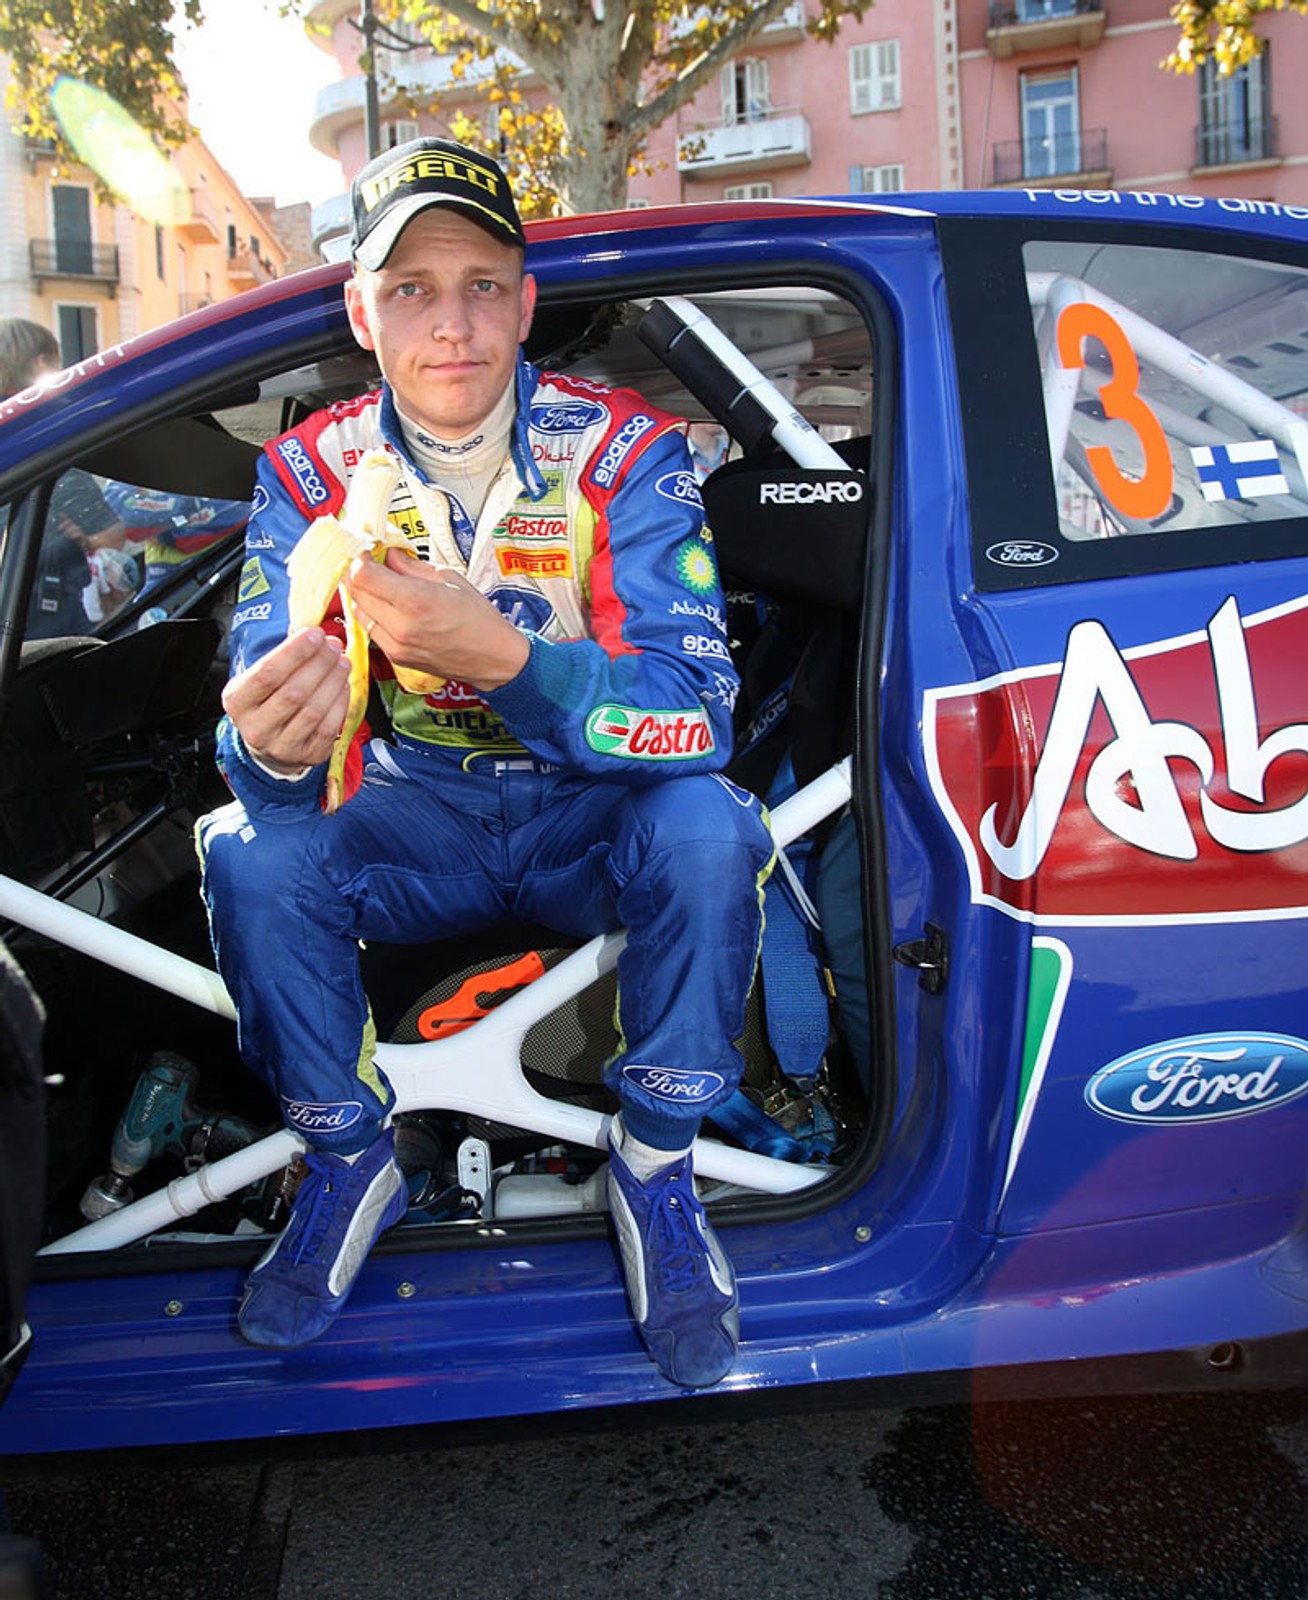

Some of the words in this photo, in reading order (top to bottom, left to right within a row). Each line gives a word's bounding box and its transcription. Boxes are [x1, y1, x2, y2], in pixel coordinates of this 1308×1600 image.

[360, 149, 499, 213] PIRELLI
[539, 406, 595, 429] Ford
[1056, 302, 1173, 520] 3
[594, 415, 654, 488] sparco
[278, 437, 328, 504] sparco
[760, 481, 863, 504] RECARO
[502, 551, 567, 573] PIRELLI
[1000, 545, 1045, 561] Ford
[641, 1070, 704, 1096] Ford
[1131, 1047, 1285, 1112] Ford
[288, 1104, 344, 1126] Ford
